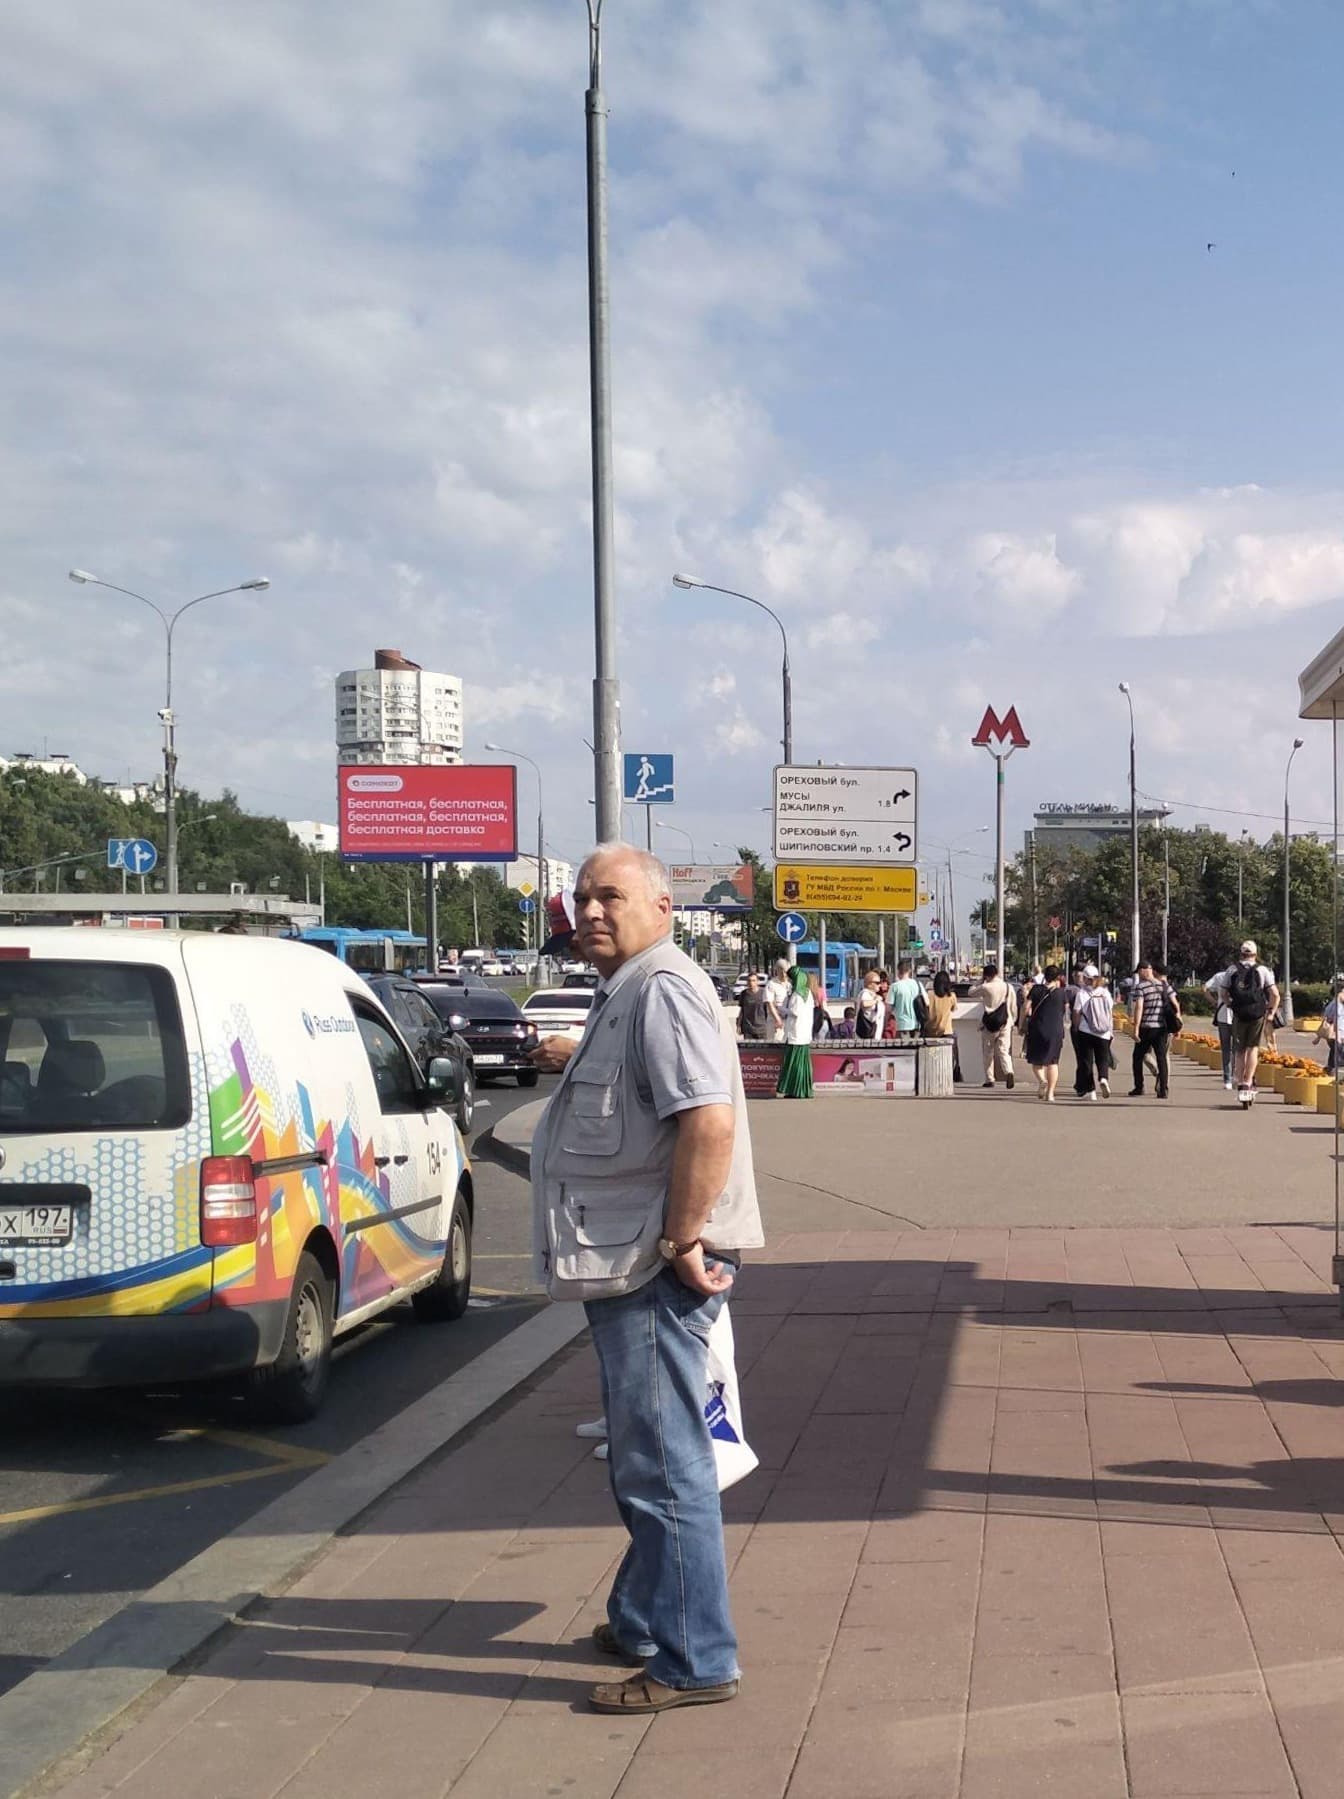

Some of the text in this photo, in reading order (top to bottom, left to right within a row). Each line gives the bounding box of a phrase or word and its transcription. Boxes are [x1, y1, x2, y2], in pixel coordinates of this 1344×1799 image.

[780, 776, 861, 788] ОРЕХОВЫЙ бул.
[780, 792, 810, 800] МУСЫ
[347, 797, 508, 810] Бесплатная, бесплатная,
[779, 803, 846, 813] ДЖАЛИЛЯ ул.
[347, 811, 508, 823] бесплатная, бесплатная,
[347, 823, 485, 835] бесплатная доставка
[779, 827, 860, 838] ОРЕХОВЫЙ бул.
[779, 842, 858, 852] ШИПИЛОВСКИЙ
[427, 1142, 440, 1176] 154
[25, 1207, 63, 1227] 197
